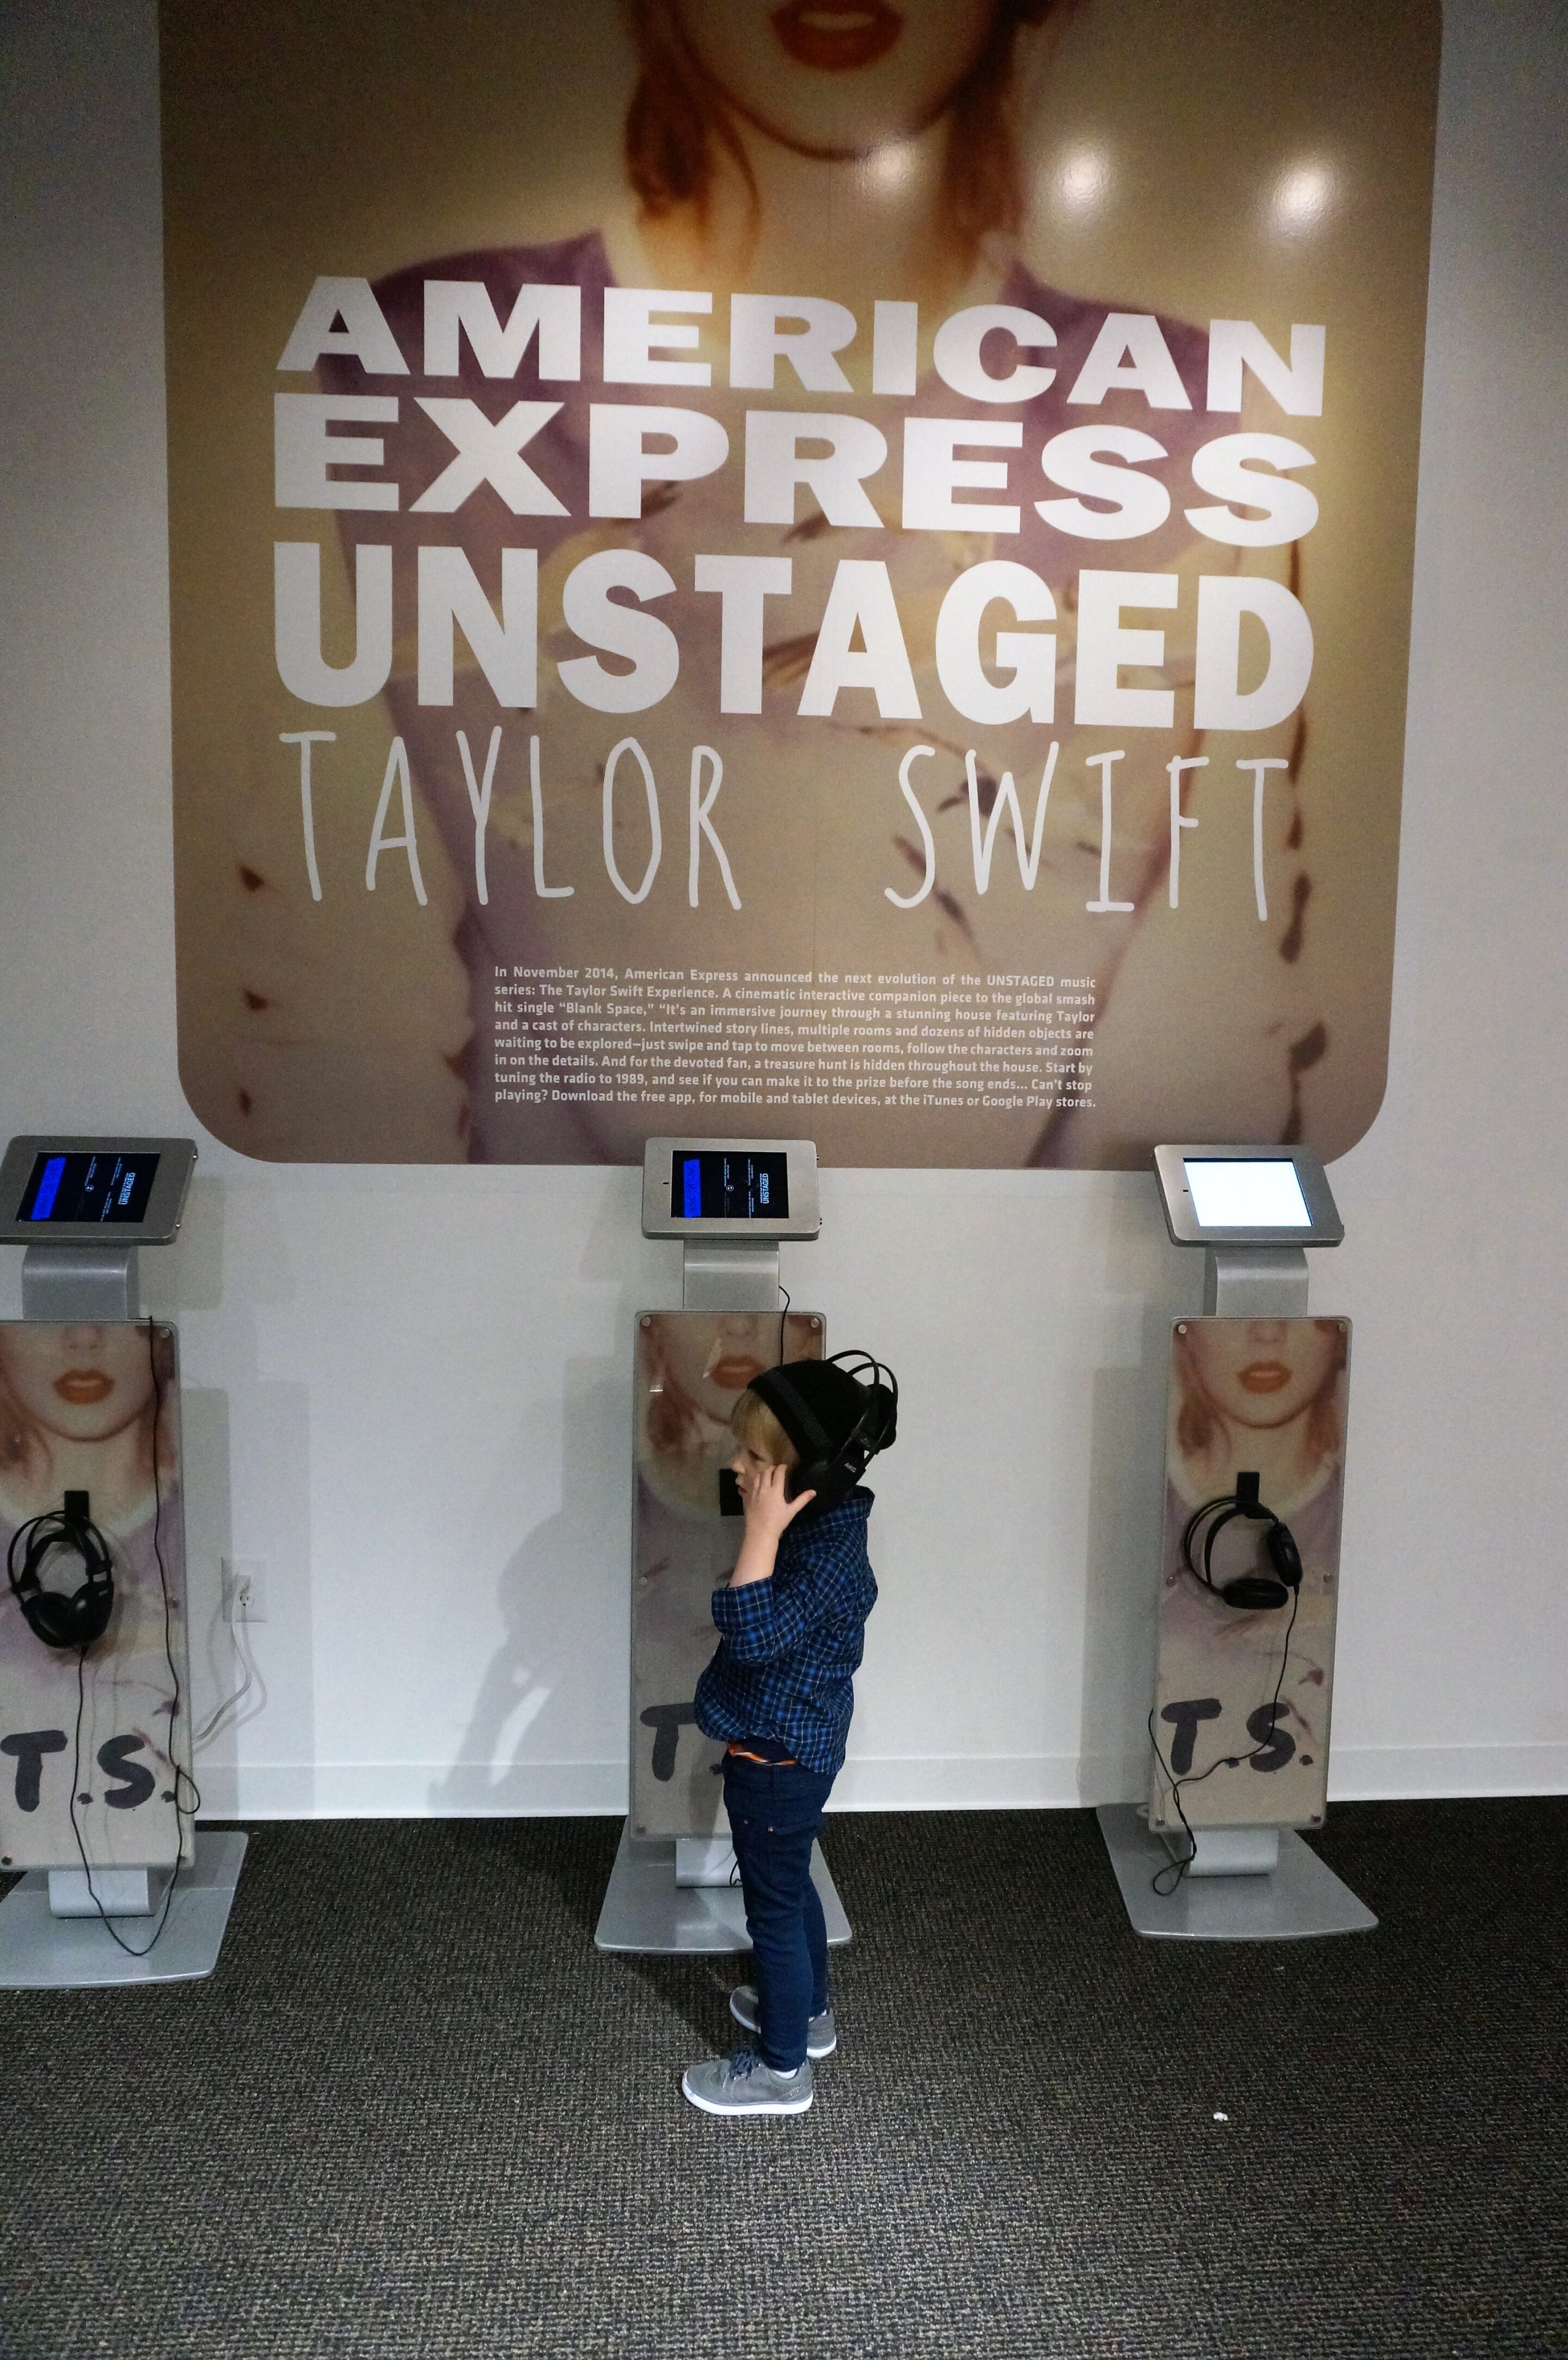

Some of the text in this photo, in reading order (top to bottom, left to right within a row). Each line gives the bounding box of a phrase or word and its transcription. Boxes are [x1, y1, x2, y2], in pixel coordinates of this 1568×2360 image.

[275, 275, 1326, 417] AMERICAN
[274, 392, 1320, 547] EXPRESS
[273, 541, 1315, 731] UNSTAGED
[279, 725, 1289, 922] TAYLOR SWIFT
[494, 965, 1096, 988] In November 2014, American Express announced the next evolution of the UNSTAGED music
[494, 983, 1095, 1007] series: The Taylor Swift Experience. A cinematic interactive companion piece to the global smash
[494, 1000, 513, 1013] hit
[517, 1001, 555, 1017] single
[690, 1006, 706, 1016] an
[710, 1004, 776, 1017] immersive
[780, 1005, 827, 1020] journey
[831, 1006, 880, 1022] through
[885, 1010, 892, 1019] a
[896, 1007, 951, 1023] stunning
[955, 1008, 991, 1020] house
[996, 1009, 1052, 1024] featuring
[1056, 1010, 1095, 1025] Taylor
[494, 1018, 1094, 1041] and a cast of characters. Intertwined story lines, multiple rooms and dozens of hidden objects are
[494, 1036, 542, 1051] waiting
[544, 1037, 558, 1048] to
[560, 1036, 575, 1049] be
[667, 1038, 703, 1053] swipe
[706, 1039, 730, 1051] and
[732, 1041, 752, 1054] tap
[755, 1041, 768, 1052] to
[770, 1043, 805, 1052] move
[807, 1041, 859, 1053] between
[862, 1044, 904, 1055] rooms,
[907, 1042, 945, 1054] follow
[947, 1043, 968, 1055] the
[970, 1043, 1033, 1055] characters
[1035, 1044, 1058, 1056] and
[1060, 1048, 1093, 1056] zoom
[494, 1053, 1093, 1076] in on the details. And for the devoted fan, a treasure hunt is hidden throughout the house. Start by
[494, 1071, 536, 1086] tuning
[538, 1071, 560, 1084] the
[564, 1072, 596, 1084] radio
[598, 1073, 612, 1084] to
[615, 1073, 648, 1086] 1989,
[652, 1073, 675, 1085] and
[678, 1076, 699, 1085] see
[702, 1073, 713, 1085] if
[715, 1077, 738, 1089] you
[741, 1077, 763, 1086] can
[766, 1075, 800, 1087] make
[804, 1075, 813, 1087] it
[816, 1076, 829, 1087] to
[832, 1075, 853, 1087] the
[856, 1075, 886, 1091] prize
[889, 1076, 929, 1089] before
[932, 1077, 952, 1089] the
[955, 1080, 984, 1092] song
[987, 1078, 1028, 1090] ends...
[1065, 1080, 1092, 1093] stop
[494, 1088, 1096, 1110] playing? Download the free app, for mobile and tablet devices, at the iTunes or Google Play stores.
[844, 1462, 857, 1473] AKG
